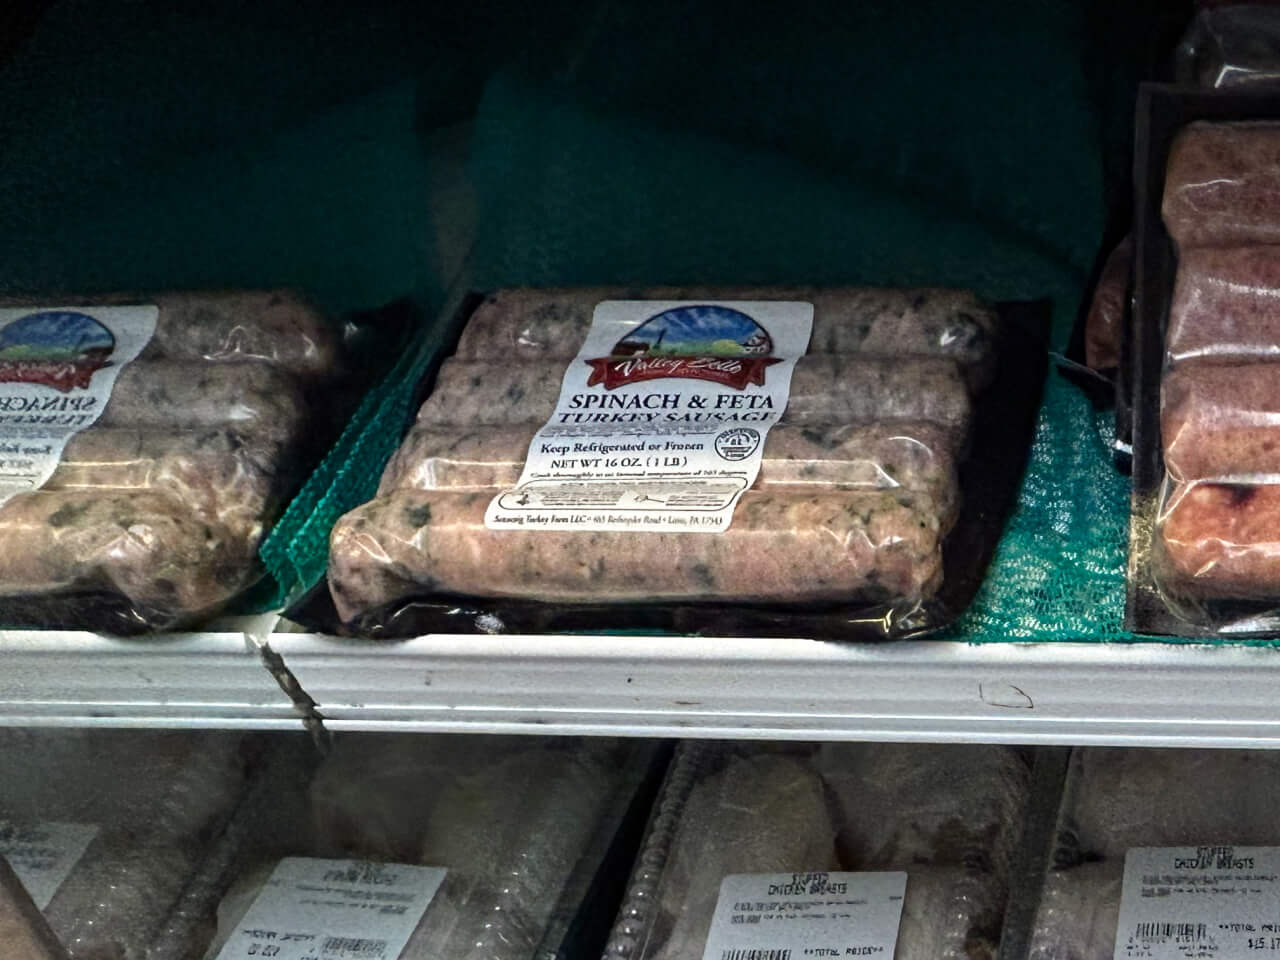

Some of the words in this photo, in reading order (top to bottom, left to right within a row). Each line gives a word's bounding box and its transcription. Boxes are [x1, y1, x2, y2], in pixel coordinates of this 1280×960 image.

[614, 356, 682, 377] Valley
[568, 394, 682, 409] SPINACH
[688, 394, 708, 409] &
[715, 394, 775, 409] FETA
[557, 412, 660, 424] TURKEY
[664, 412, 777, 423] SAUSAGE
[540, 442, 570, 455] Keep
[574, 441, 645, 454] Refrigerated
[663, 441, 704, 451] Frozen
[550, 458, 576, 469] NET
[580, 458, 602, 468] WT
[604, 457, 618, 468] 16
